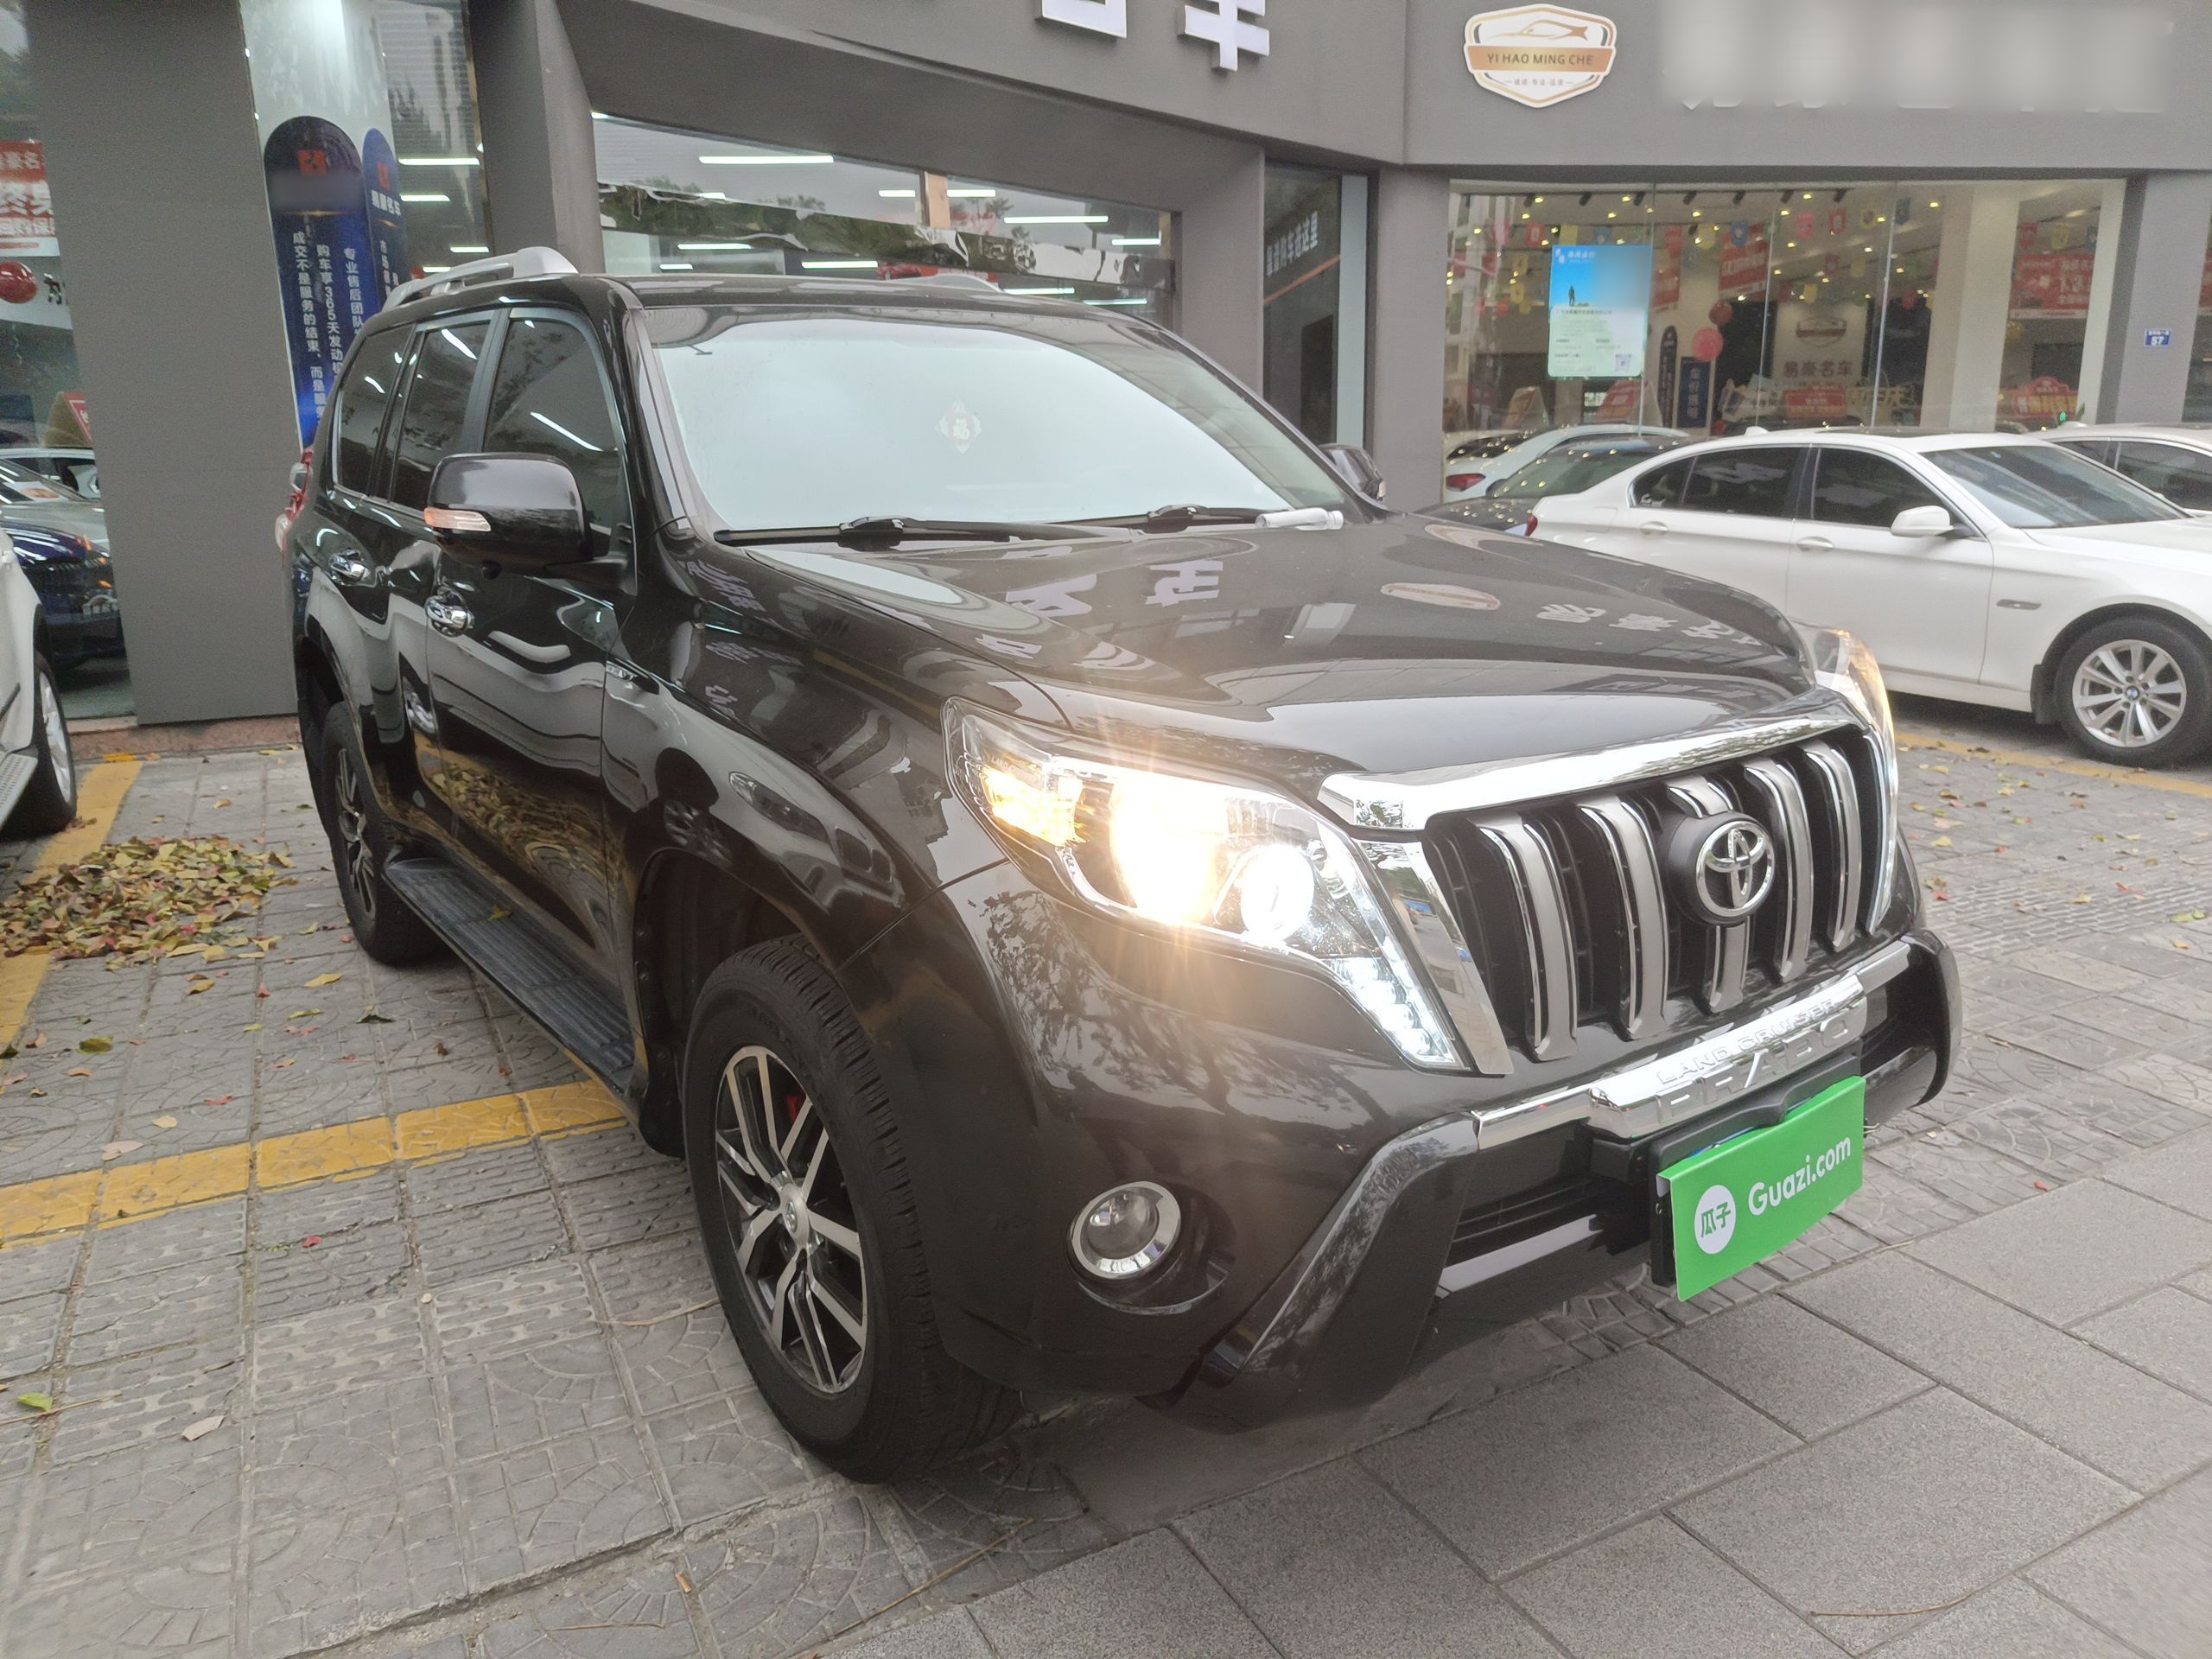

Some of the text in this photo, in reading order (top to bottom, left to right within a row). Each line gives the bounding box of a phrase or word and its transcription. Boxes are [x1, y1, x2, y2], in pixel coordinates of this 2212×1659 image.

[1486, 54, 1594, 67] YI HAO MING CHE
[1655, 1007, 1851, 1122] PRADO
[1656, 997, 1839, 1084] LAND CRUISER
[1747, 1137, 1851, 1217] Guazi.com
[1700, 1201, 1732, 1238] 瓜子
